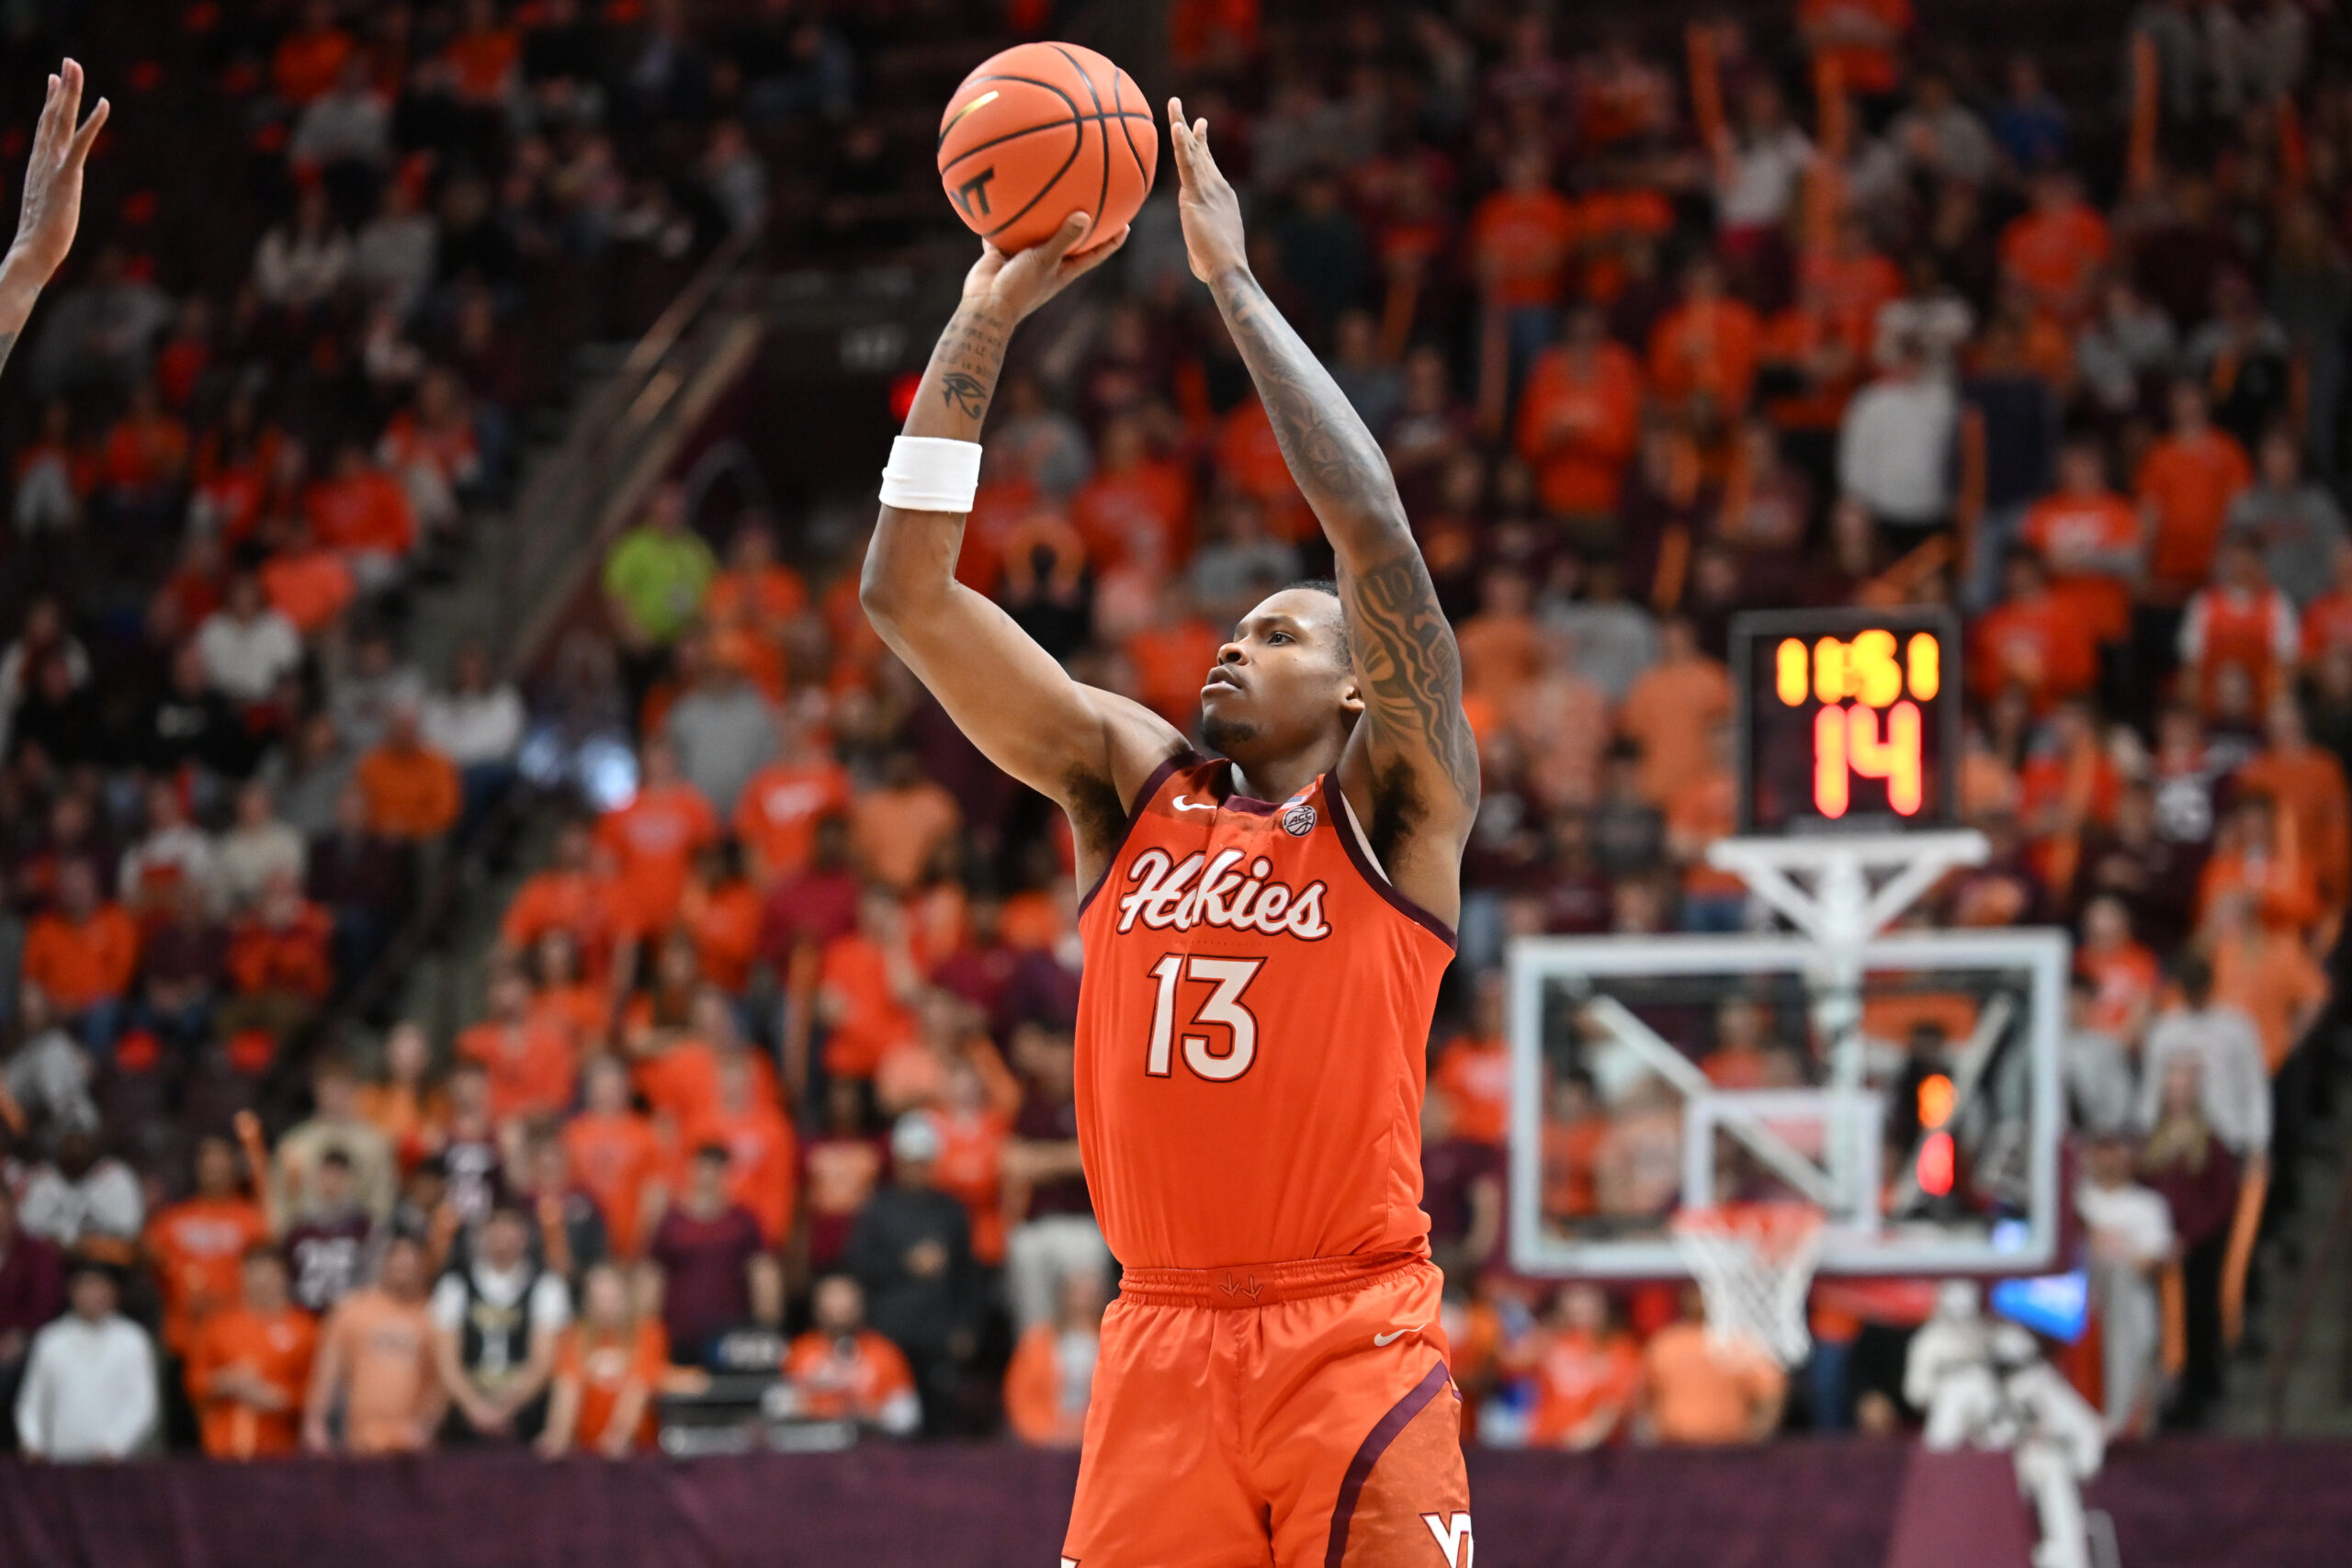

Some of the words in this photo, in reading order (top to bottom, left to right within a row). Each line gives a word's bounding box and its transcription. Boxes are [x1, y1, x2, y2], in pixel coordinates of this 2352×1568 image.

[1288, 810, 1313, 825] ACC
[1815, 701, 1922, 818] 14
[1146, 953, 1267, 1082] 13
